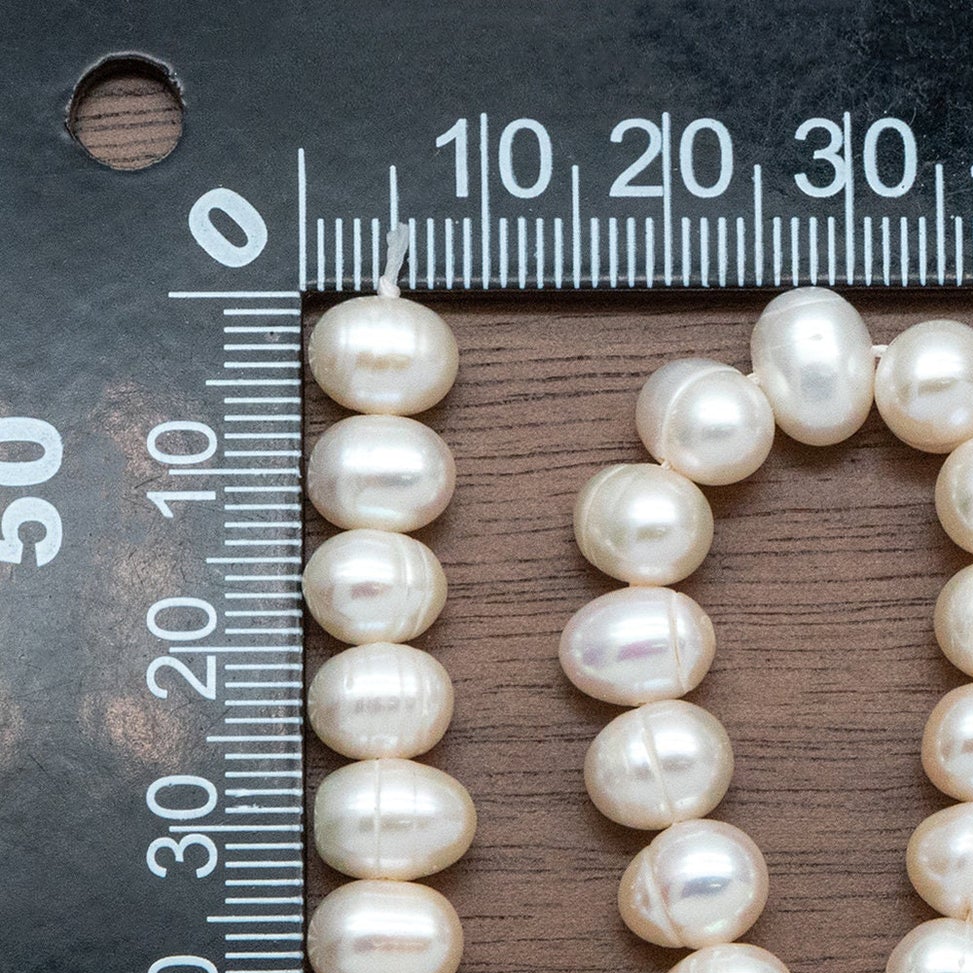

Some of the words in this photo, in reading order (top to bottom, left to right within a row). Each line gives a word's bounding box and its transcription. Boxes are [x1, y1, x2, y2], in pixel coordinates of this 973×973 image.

[436, 118, 552, 198] 10
[609, 118, 733, 198] 20
[795, 118, 917, 197] 30
[189, 188, 268, 268] 0
[0, 417, 63, 568] 50
[147, 421, 218, 518] 10
[147, 597, 218, 699] 20
[147, 775, 218, 878] 30
